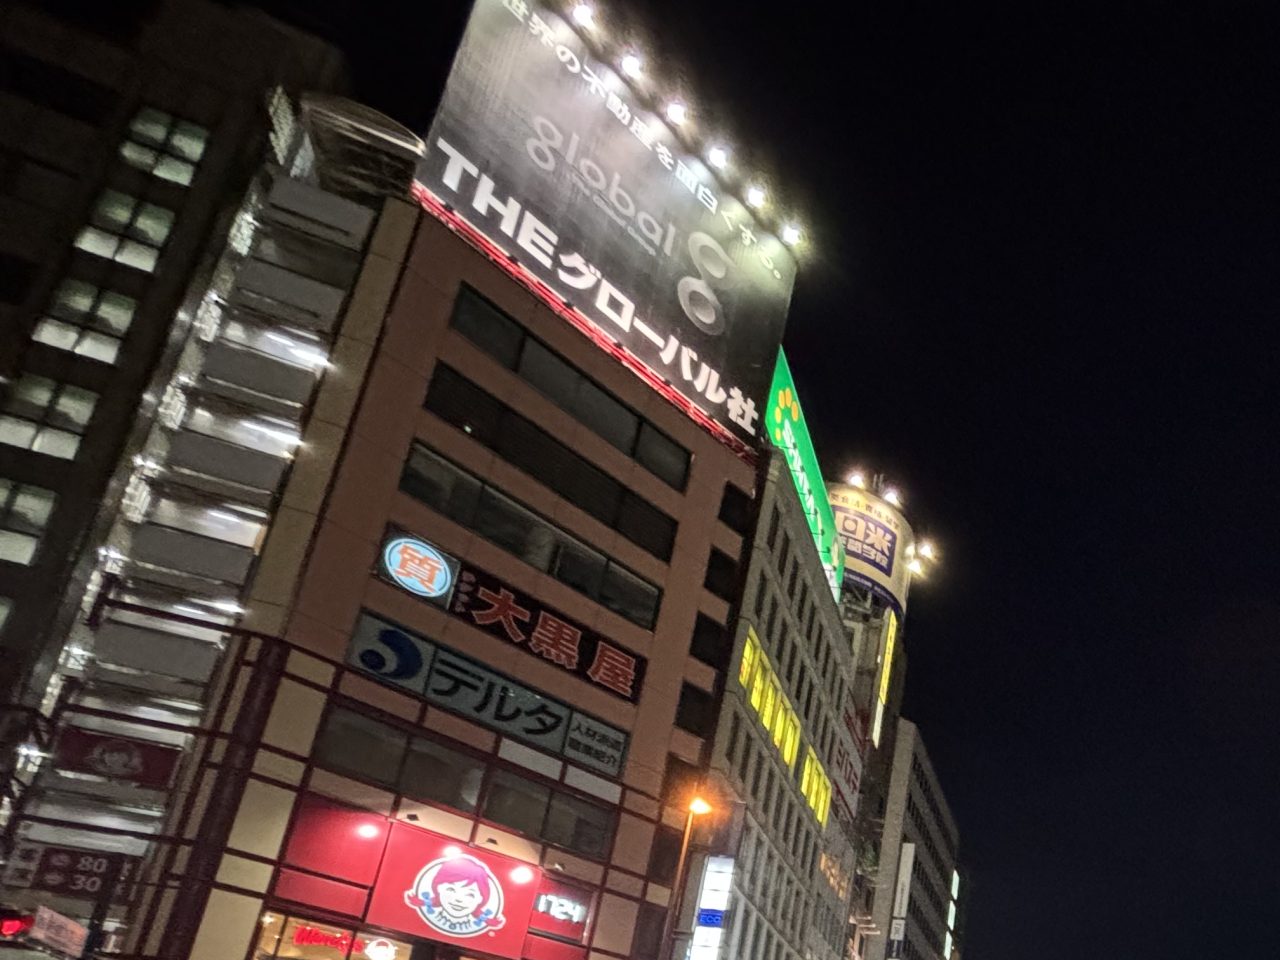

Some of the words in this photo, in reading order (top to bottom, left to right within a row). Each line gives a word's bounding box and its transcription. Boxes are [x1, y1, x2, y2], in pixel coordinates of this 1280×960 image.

[394, 544, 443, 595] 質
[471, 588, 637, 698] 大黒屋
[431, 653, 564, 735] デルタ
[293, 927, 364, 955] Wendy's
